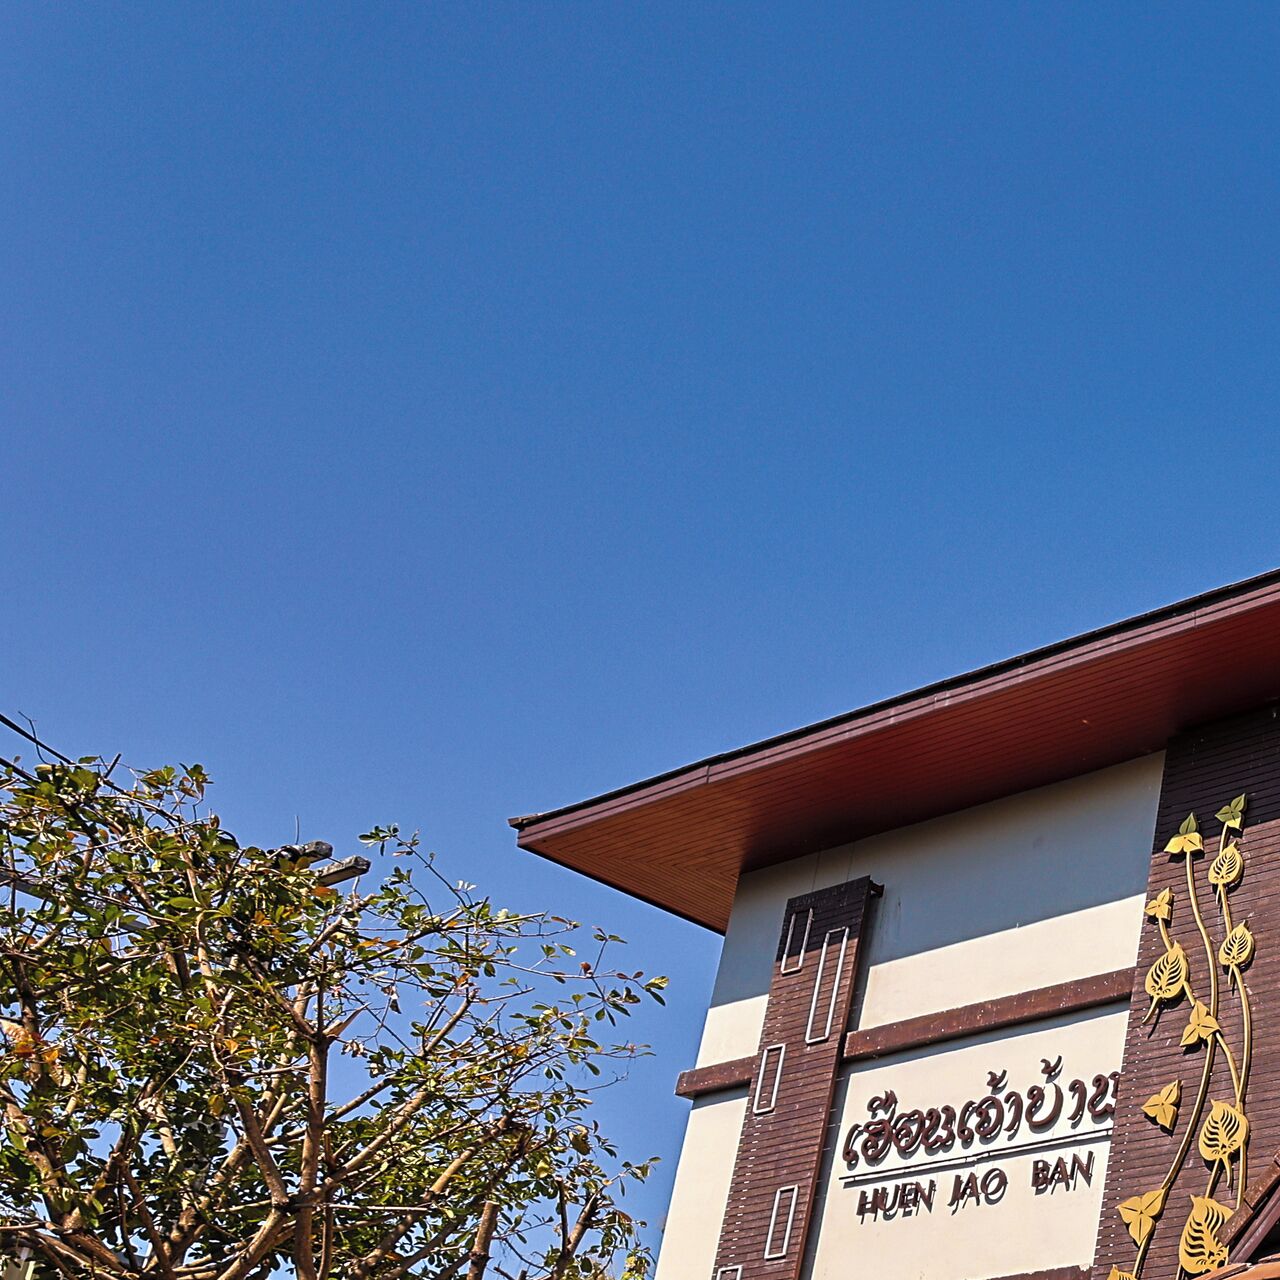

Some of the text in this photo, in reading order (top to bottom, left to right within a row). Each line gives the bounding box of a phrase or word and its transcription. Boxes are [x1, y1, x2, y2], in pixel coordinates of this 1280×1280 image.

[855, 1150, 1094, 1217] HUEN JAO BAN
